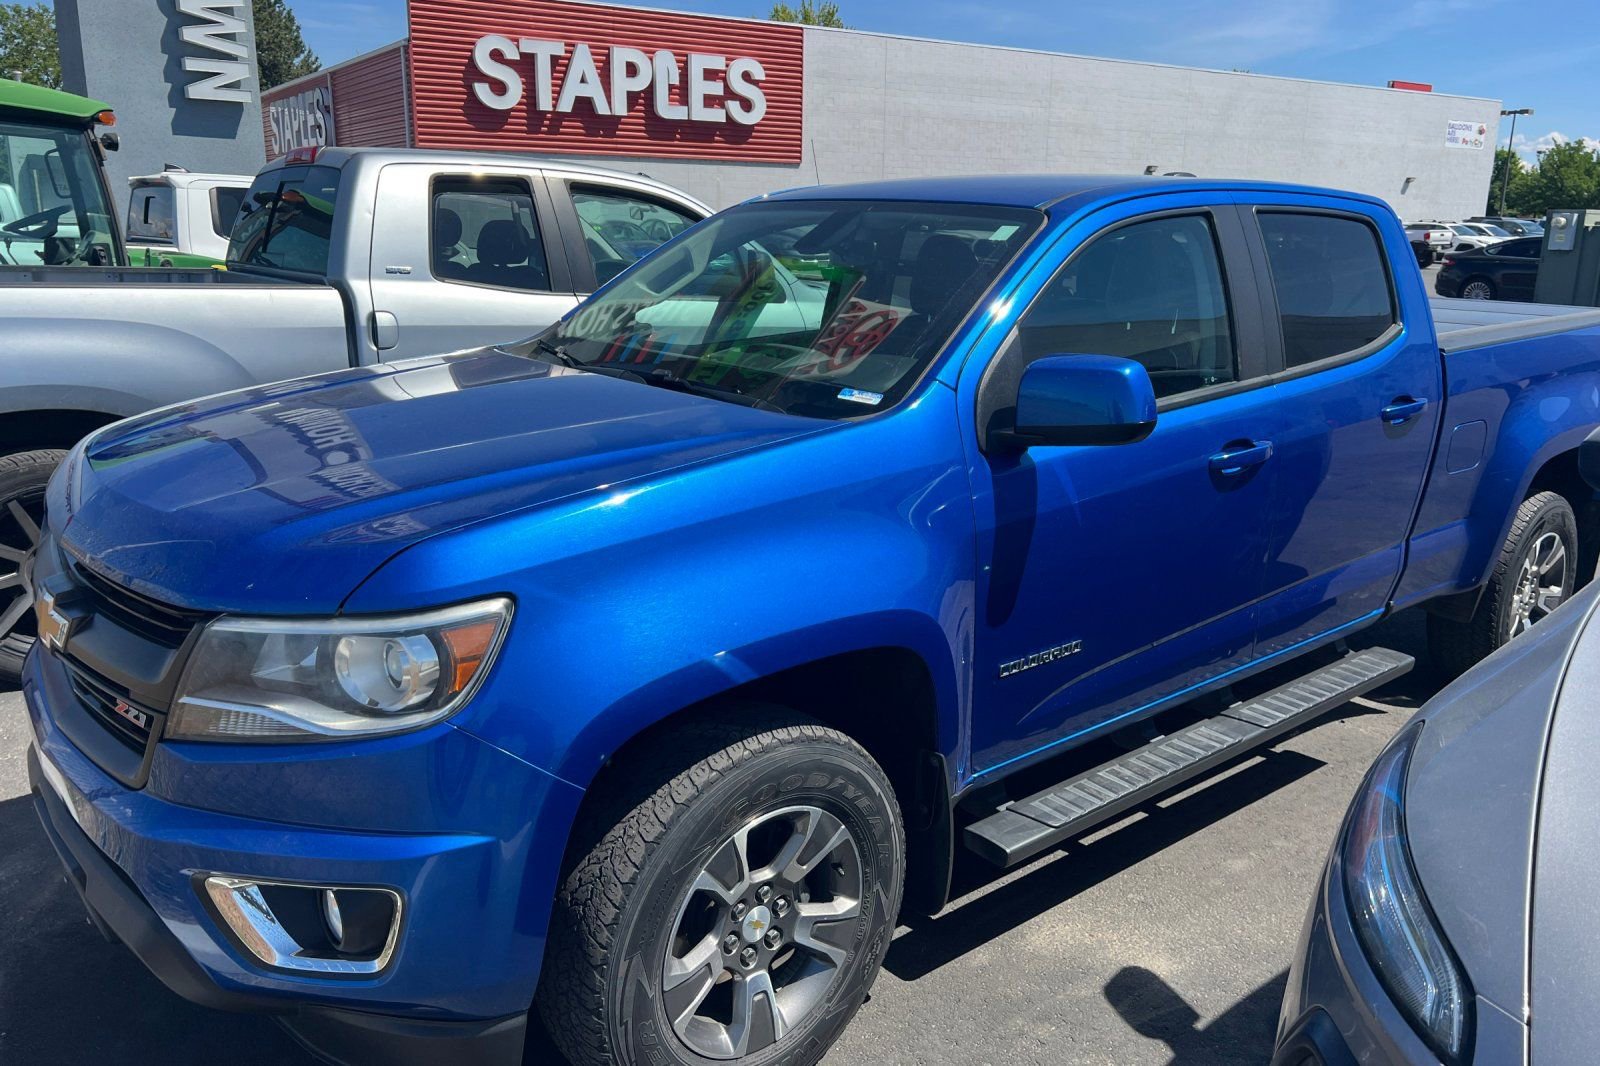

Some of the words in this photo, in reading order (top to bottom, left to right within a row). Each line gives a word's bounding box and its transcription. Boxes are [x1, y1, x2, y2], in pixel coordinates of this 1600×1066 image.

[471, 33, 767, 126] STAPLES
[269, 87, 327, 155] STAPLES
[999, 639, 1082, 677] COLORADO
[114, 698, 147, 729] Z71
[720, 772, 891, 870] GOODYEAR
